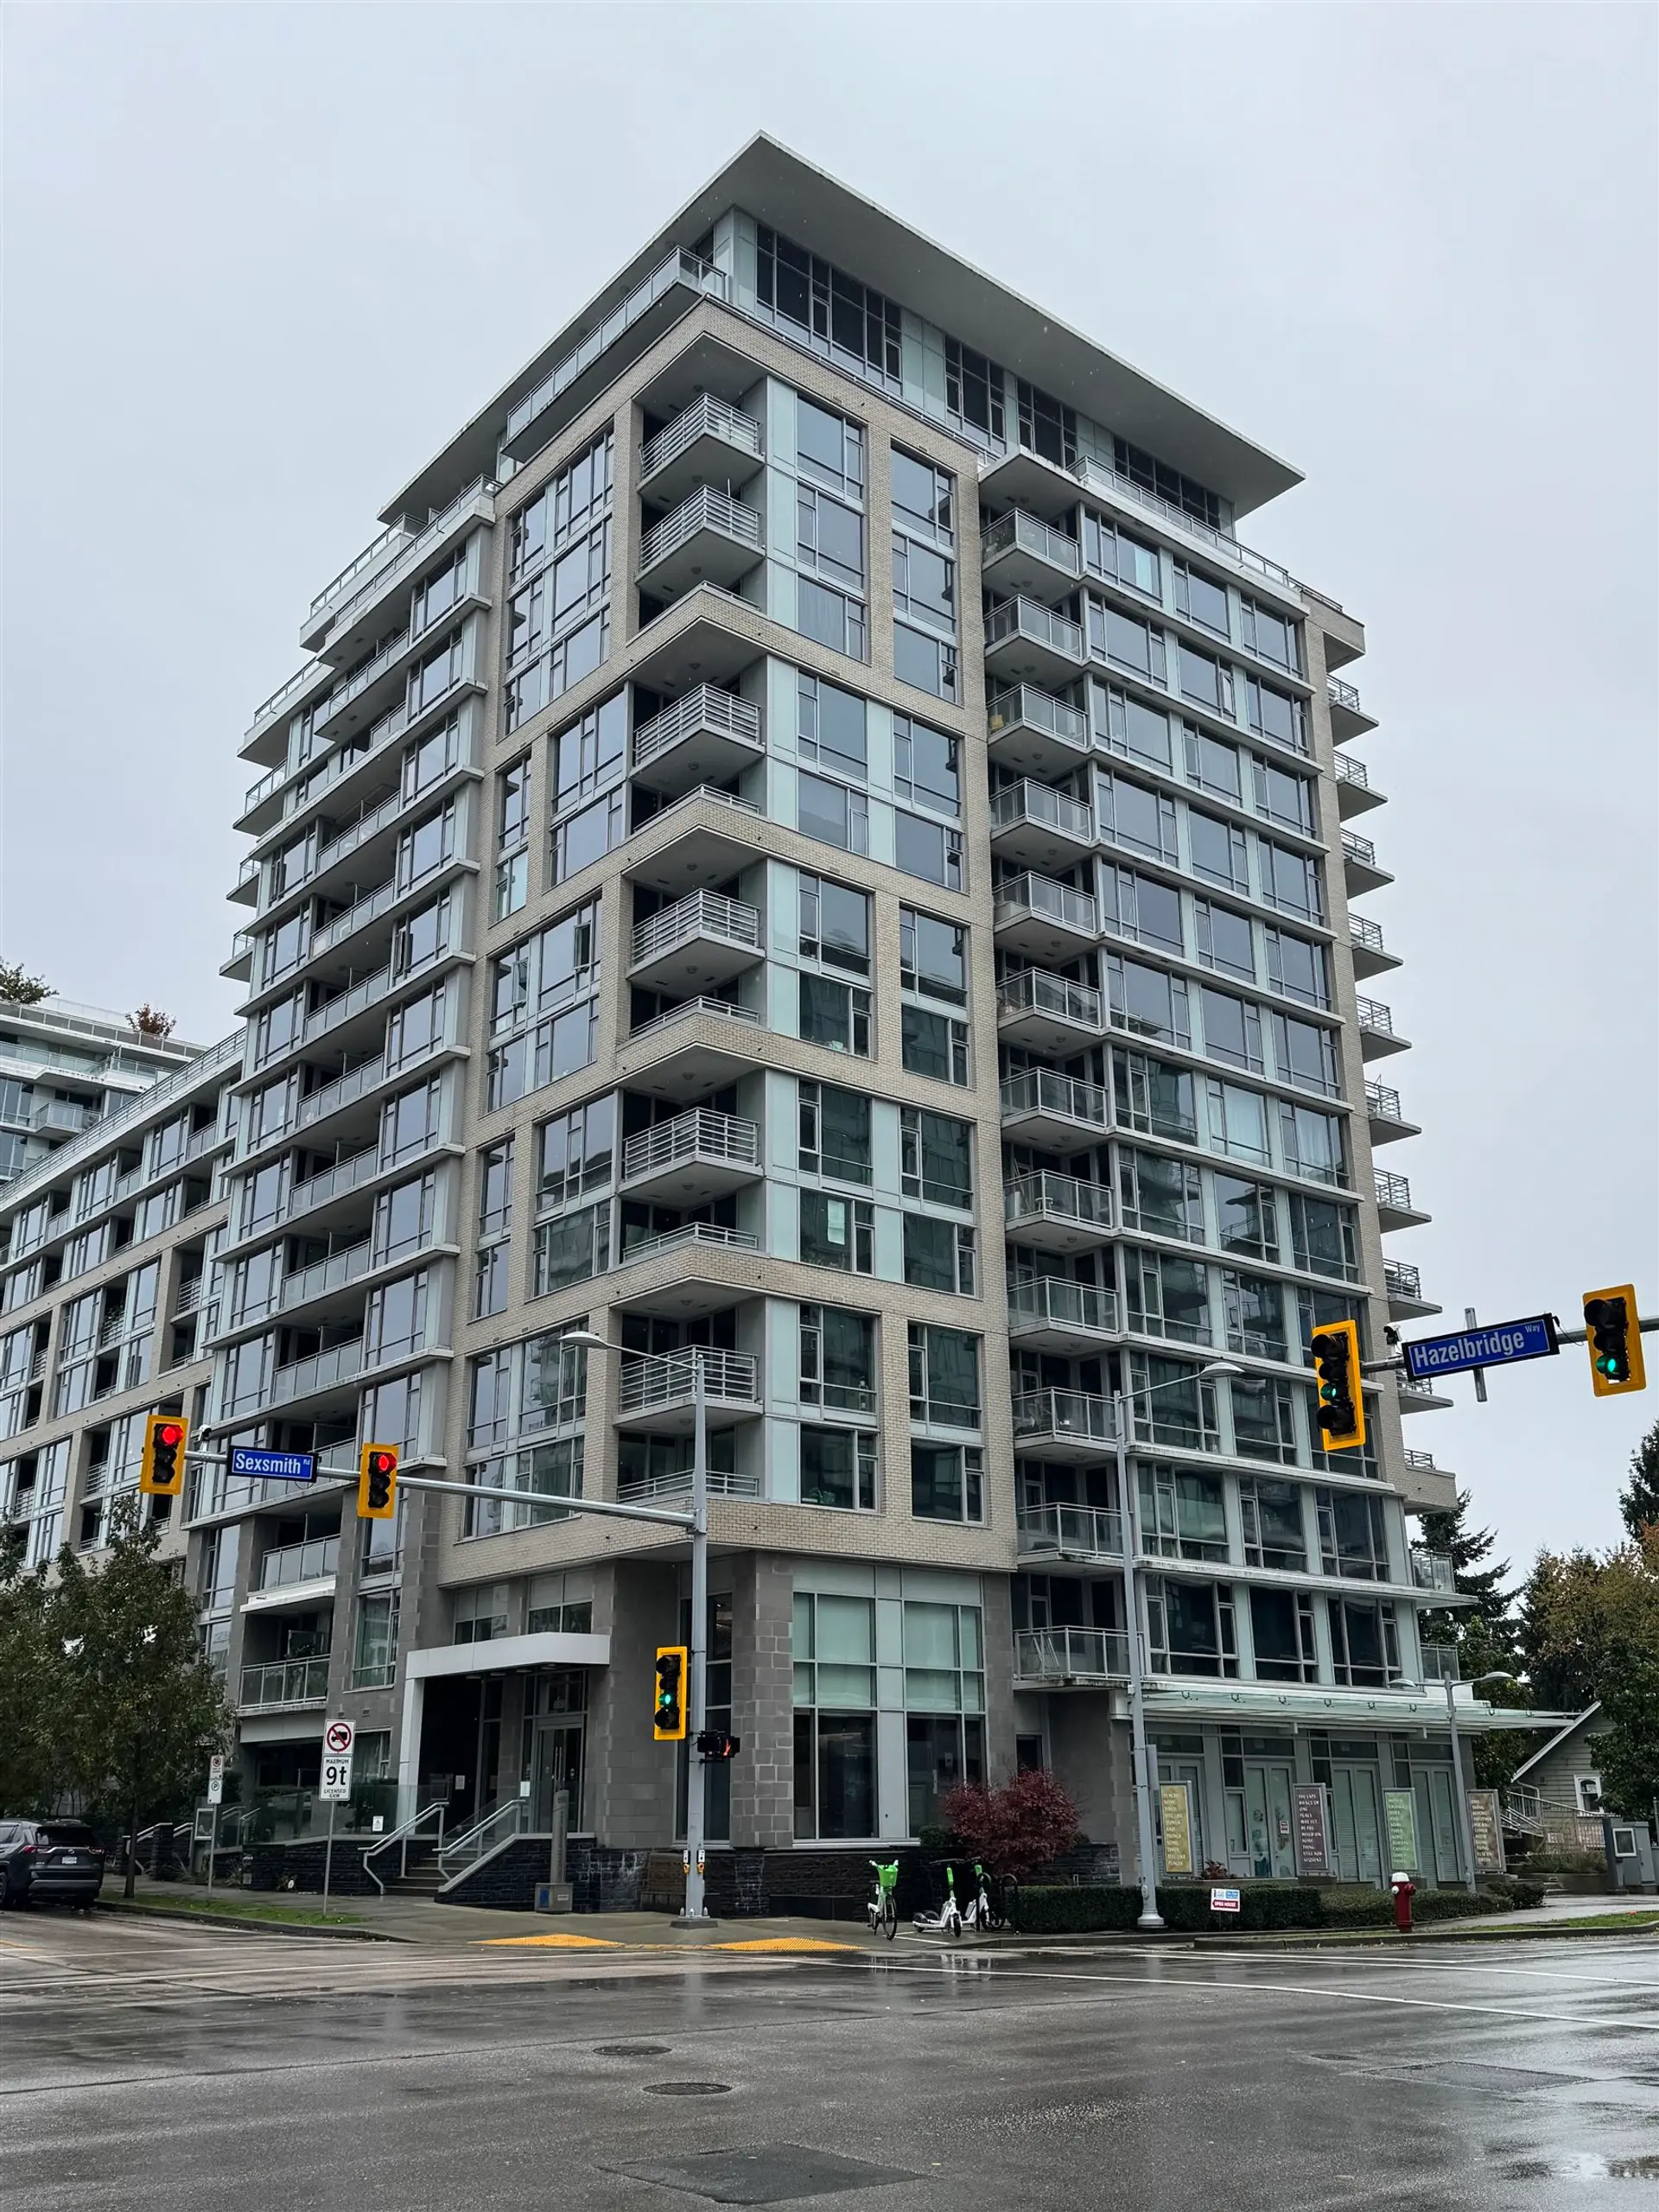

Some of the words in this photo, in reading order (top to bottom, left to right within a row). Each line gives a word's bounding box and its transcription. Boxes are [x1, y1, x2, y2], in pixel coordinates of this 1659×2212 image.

[1414, 1332, 1525, 1369] Hazelbridge
[1524, 1324, 1541, 1333] Way
[235, 1452, 301, 1474] Sexsmith
[326, 1766, 346, 1786] 9t
